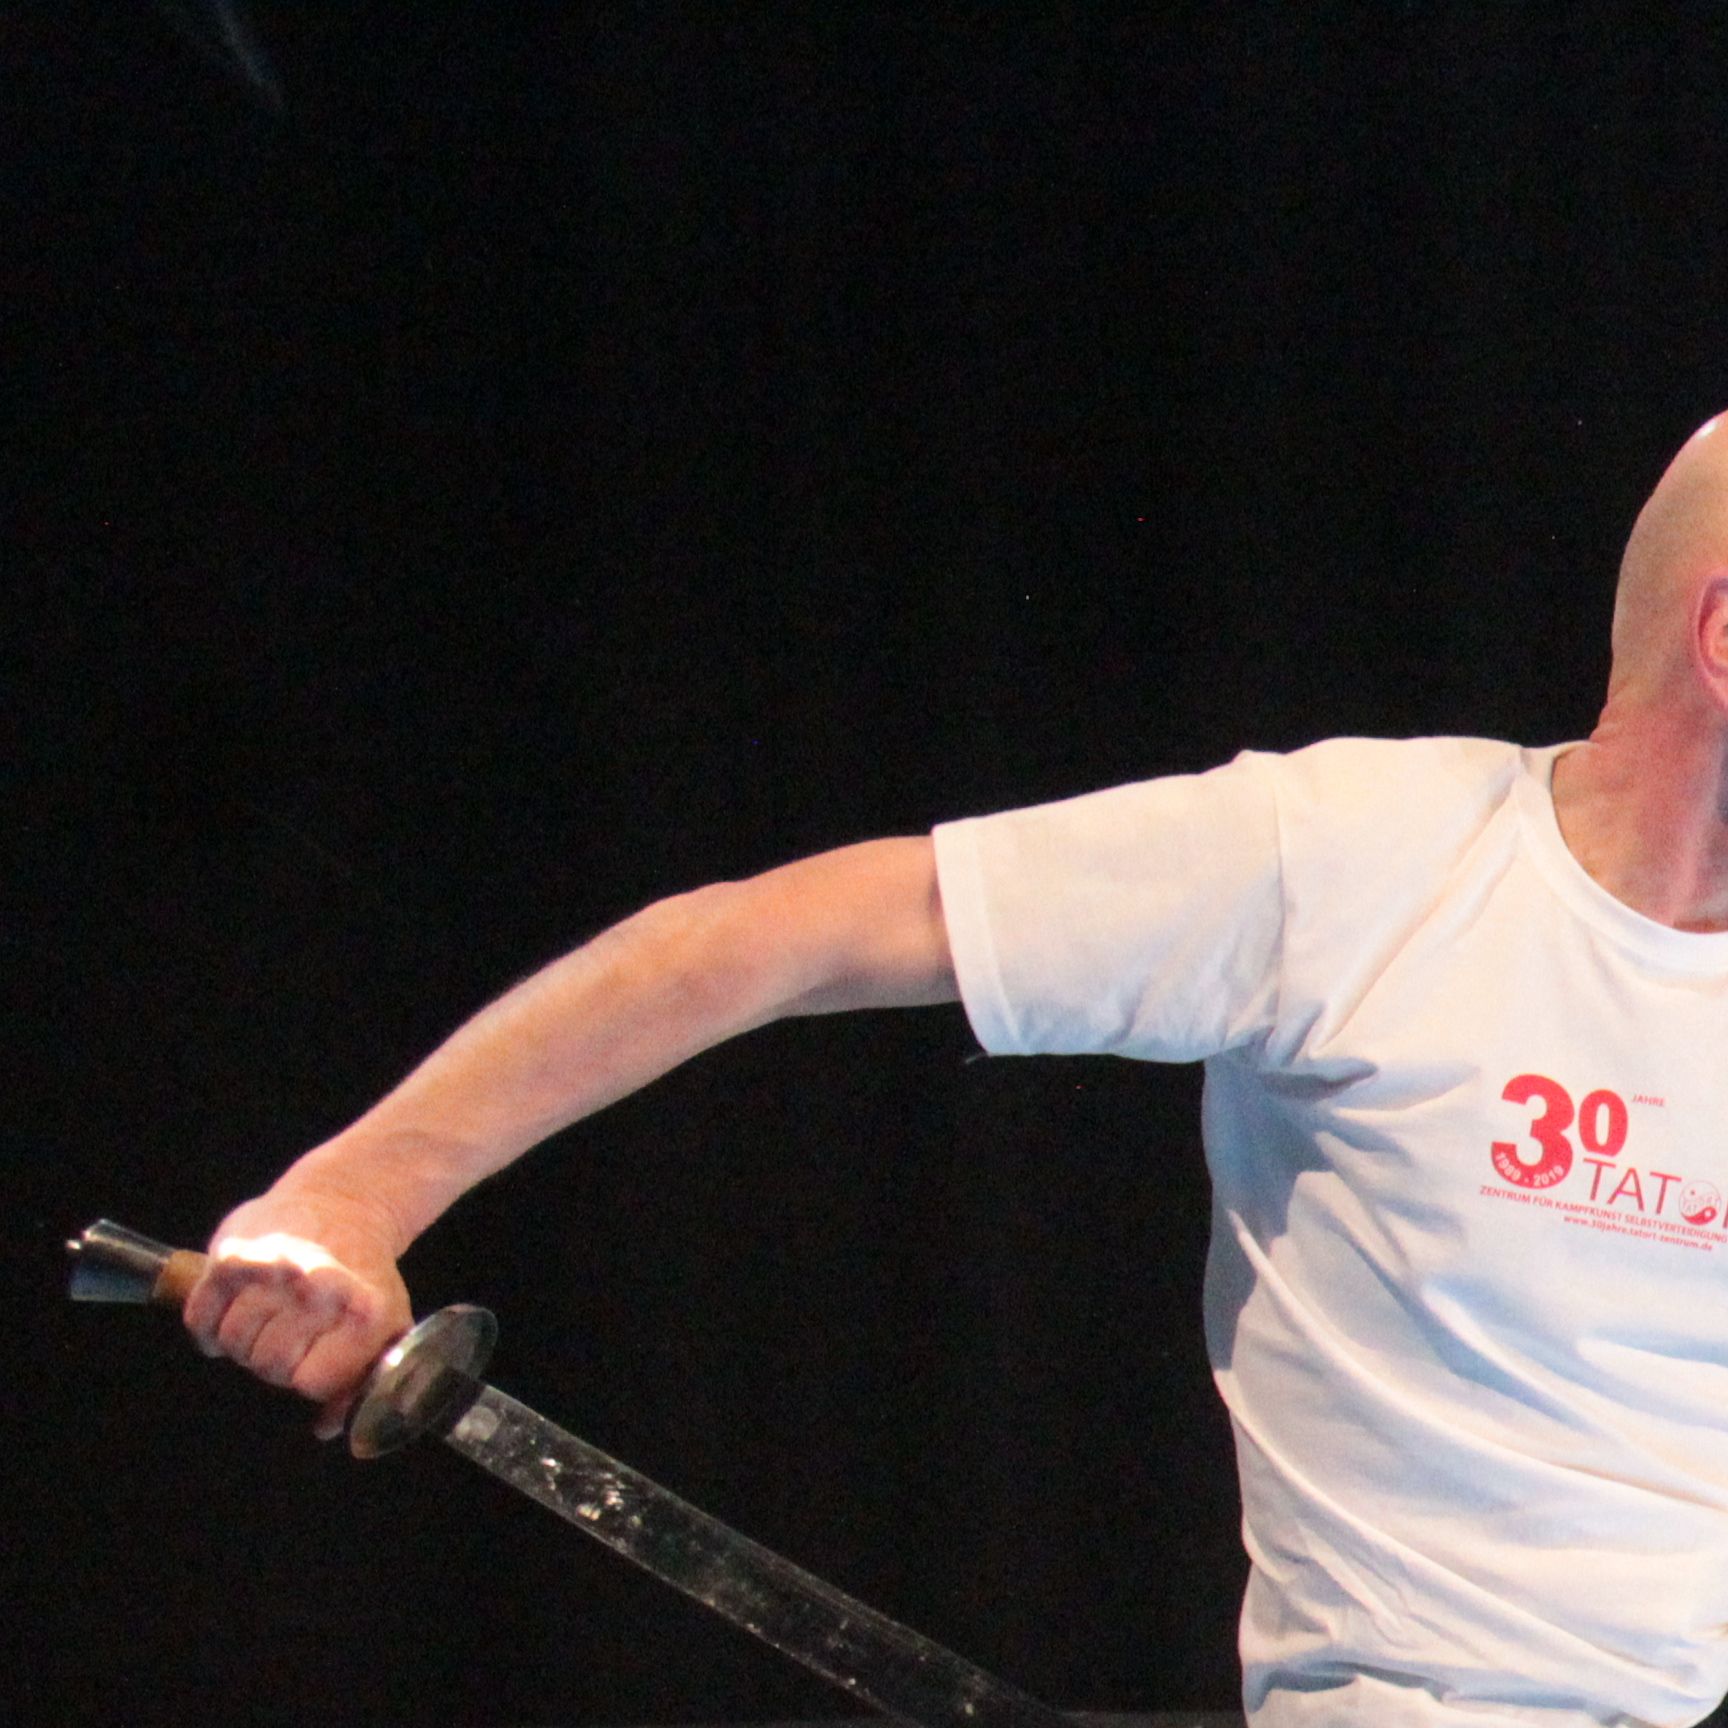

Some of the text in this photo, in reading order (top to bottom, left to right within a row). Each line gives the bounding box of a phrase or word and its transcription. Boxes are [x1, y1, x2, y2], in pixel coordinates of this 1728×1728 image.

[1491, 1073, 1629, 1189] 30
[1480, 1185, 1531, 1205] ZENTRUM
[1532, 1195, 1554, 1209] FÜR
[1555, 1200, 1623, 1222] KAMPFKUNST
[1624, 1214, 1728, 1243] SELBSTVERTEIDIGUNG
